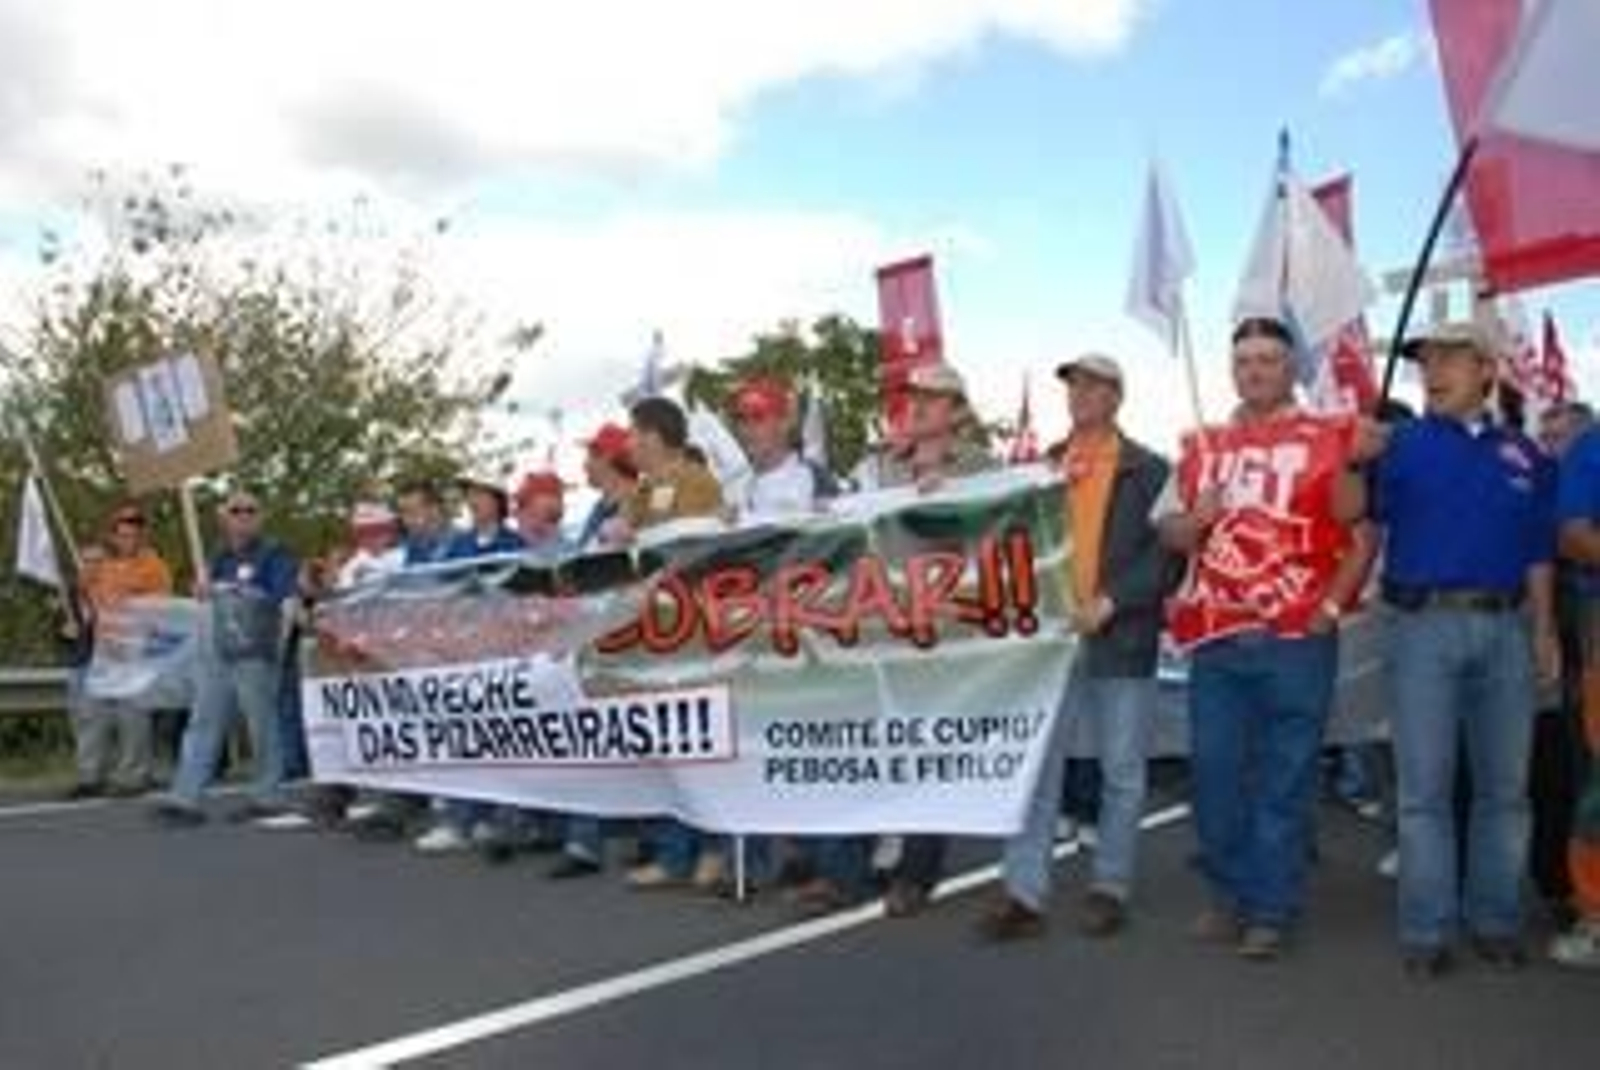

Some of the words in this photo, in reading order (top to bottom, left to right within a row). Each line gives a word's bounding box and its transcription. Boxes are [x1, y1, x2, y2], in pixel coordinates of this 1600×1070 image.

[1197, 443, 1310, 516] UGT
[422, 662, 536, 713] PECHE
[359, 722, 418, 764] DAS
[888, 756, 908, 782] E
